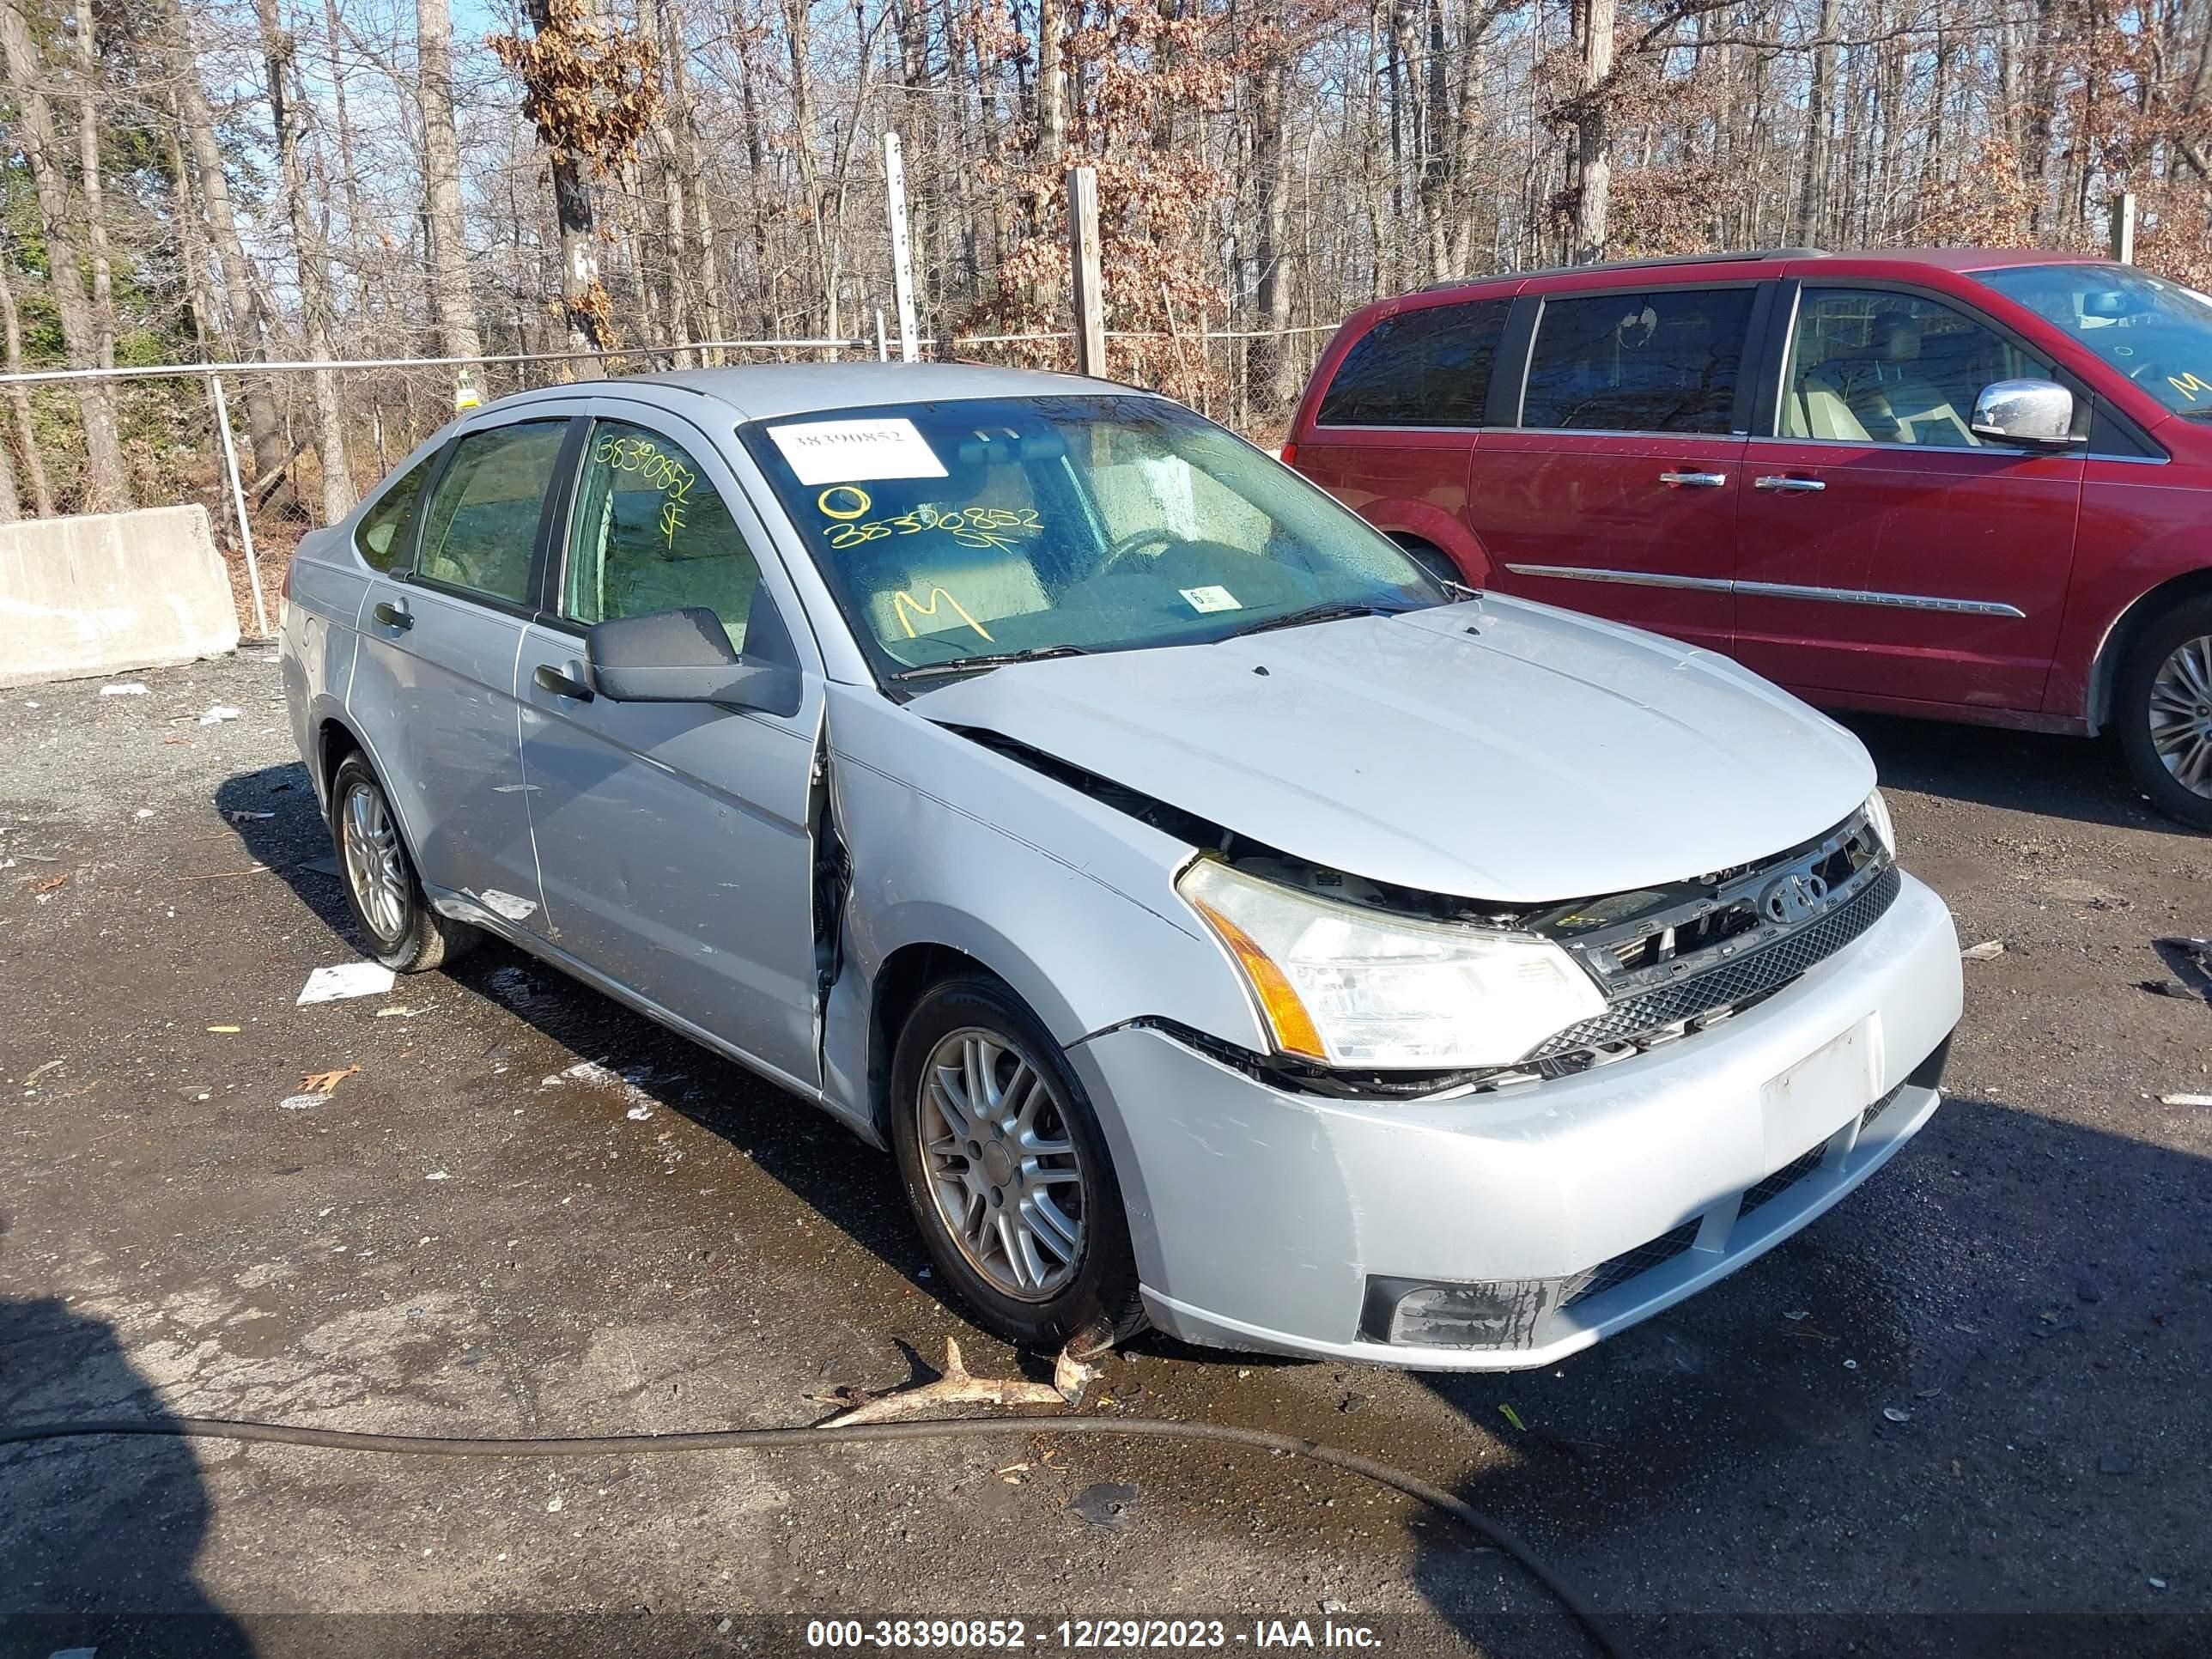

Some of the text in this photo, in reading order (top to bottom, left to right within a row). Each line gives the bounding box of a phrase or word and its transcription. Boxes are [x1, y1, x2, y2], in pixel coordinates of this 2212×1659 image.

[2166, 372, 2212, 403] M
[793, 431, 905, 448] 38390852
[595, 434, 695, 505] 38390852
[823, 507, 1045, 550] 38390852
[892, 586, 996, 643] M
